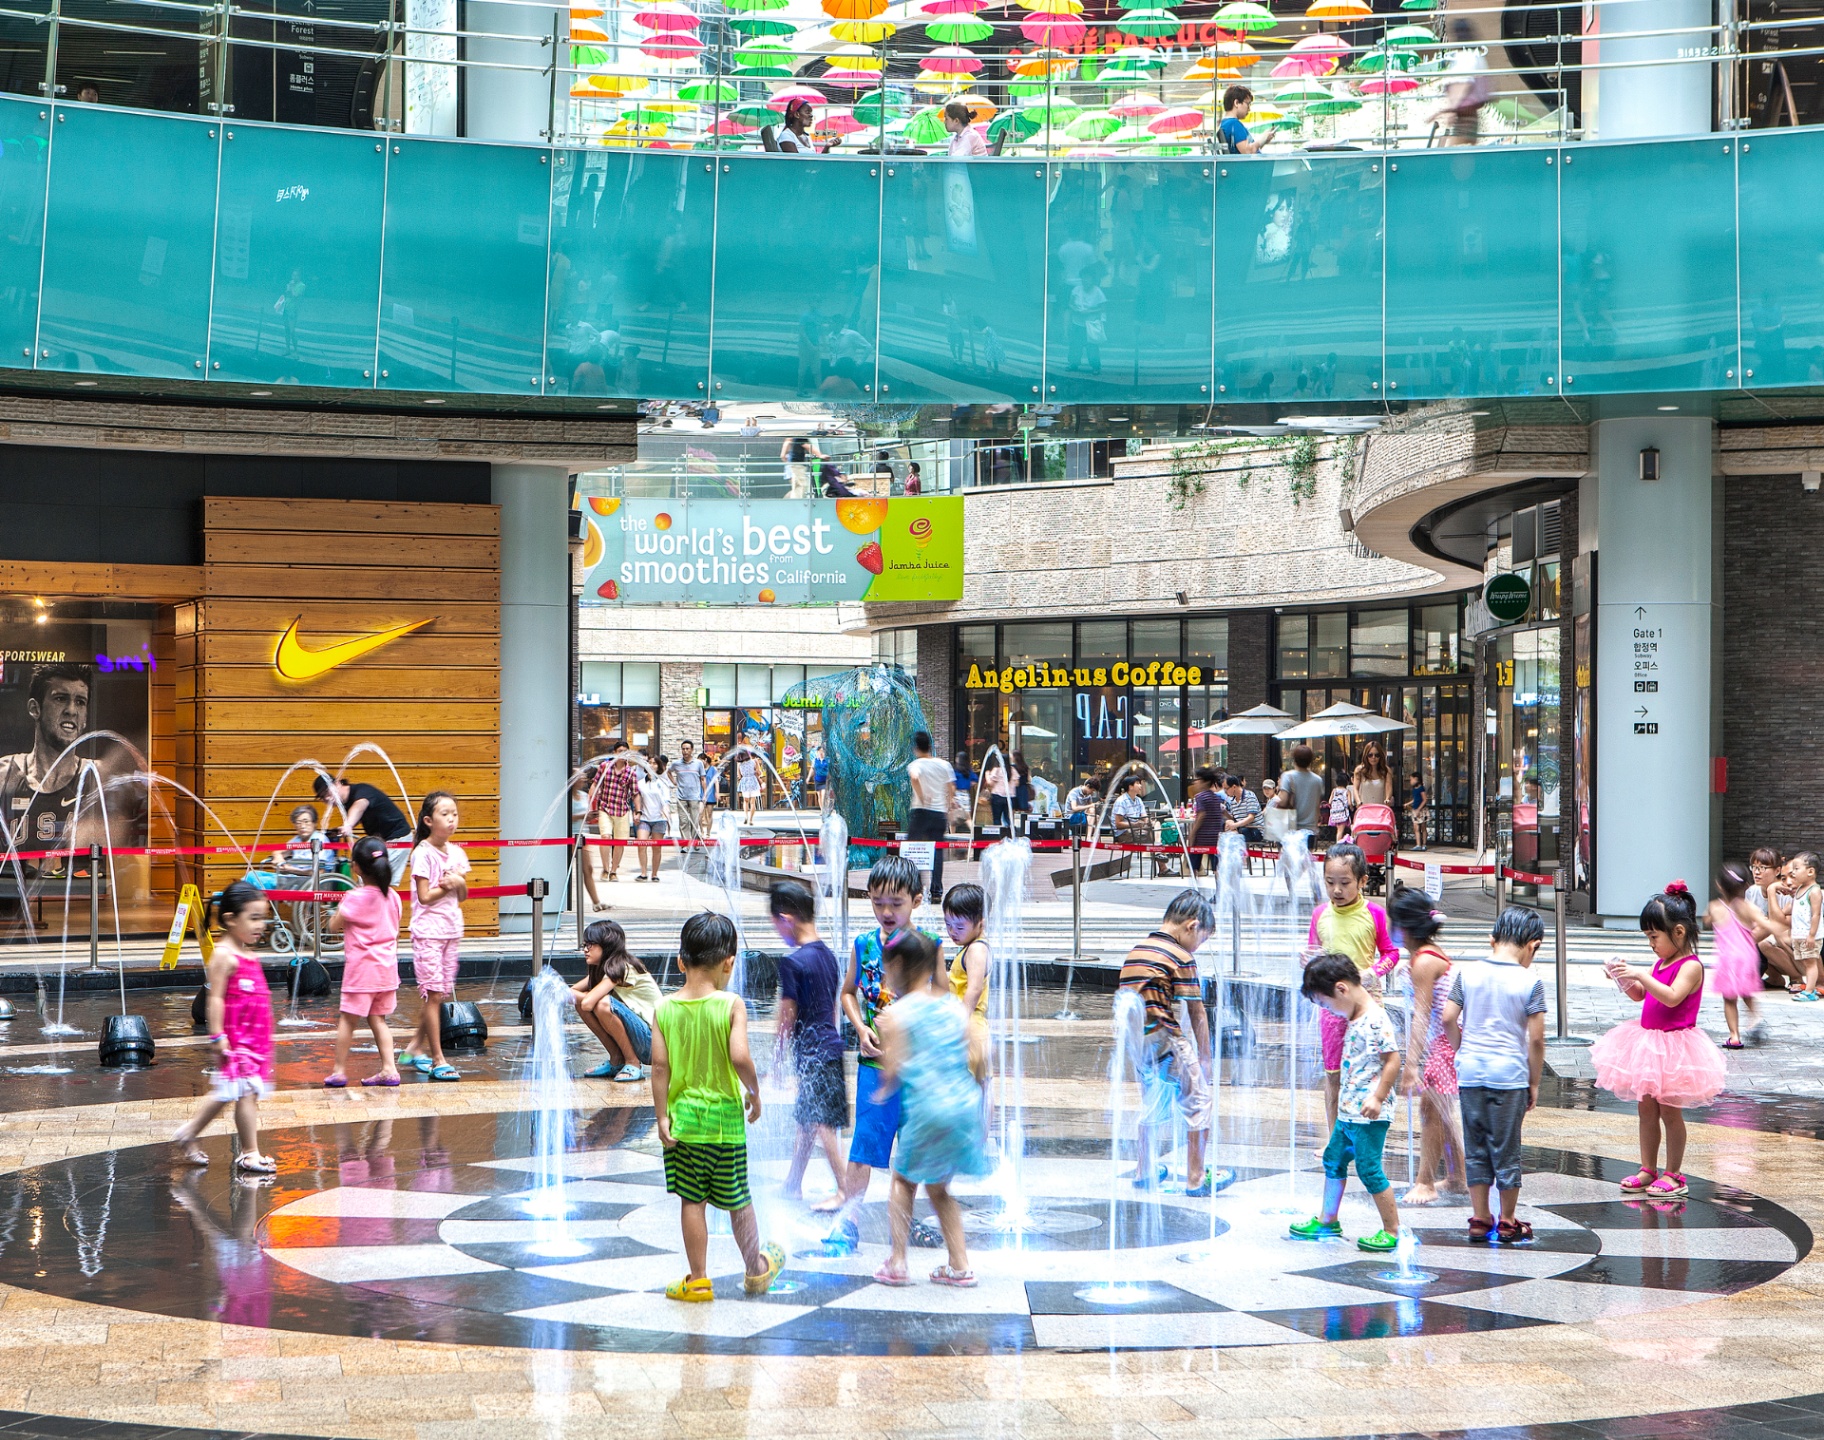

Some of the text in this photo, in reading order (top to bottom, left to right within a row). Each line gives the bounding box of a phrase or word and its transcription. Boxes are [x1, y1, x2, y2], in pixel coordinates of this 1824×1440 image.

[291, 25, 314, 34] Forest
[620, 516, 647, 531] the
[743, 515, 834, 555] best
[769, 554, 793, 563] from
[620, 556, 847, 584] smoothies California
[889, 559, 950, 570] Jamba Juice
[1633, 628, 1663, 639] Gate 1
[1633, 642, 1658, 653] 합정역
[0, 650, 66, 663] SPORTSWEAR
[1634, 661, 1659, 672] 오피스
[965, 661, 1202, 694] Angel-in-us Coffee
